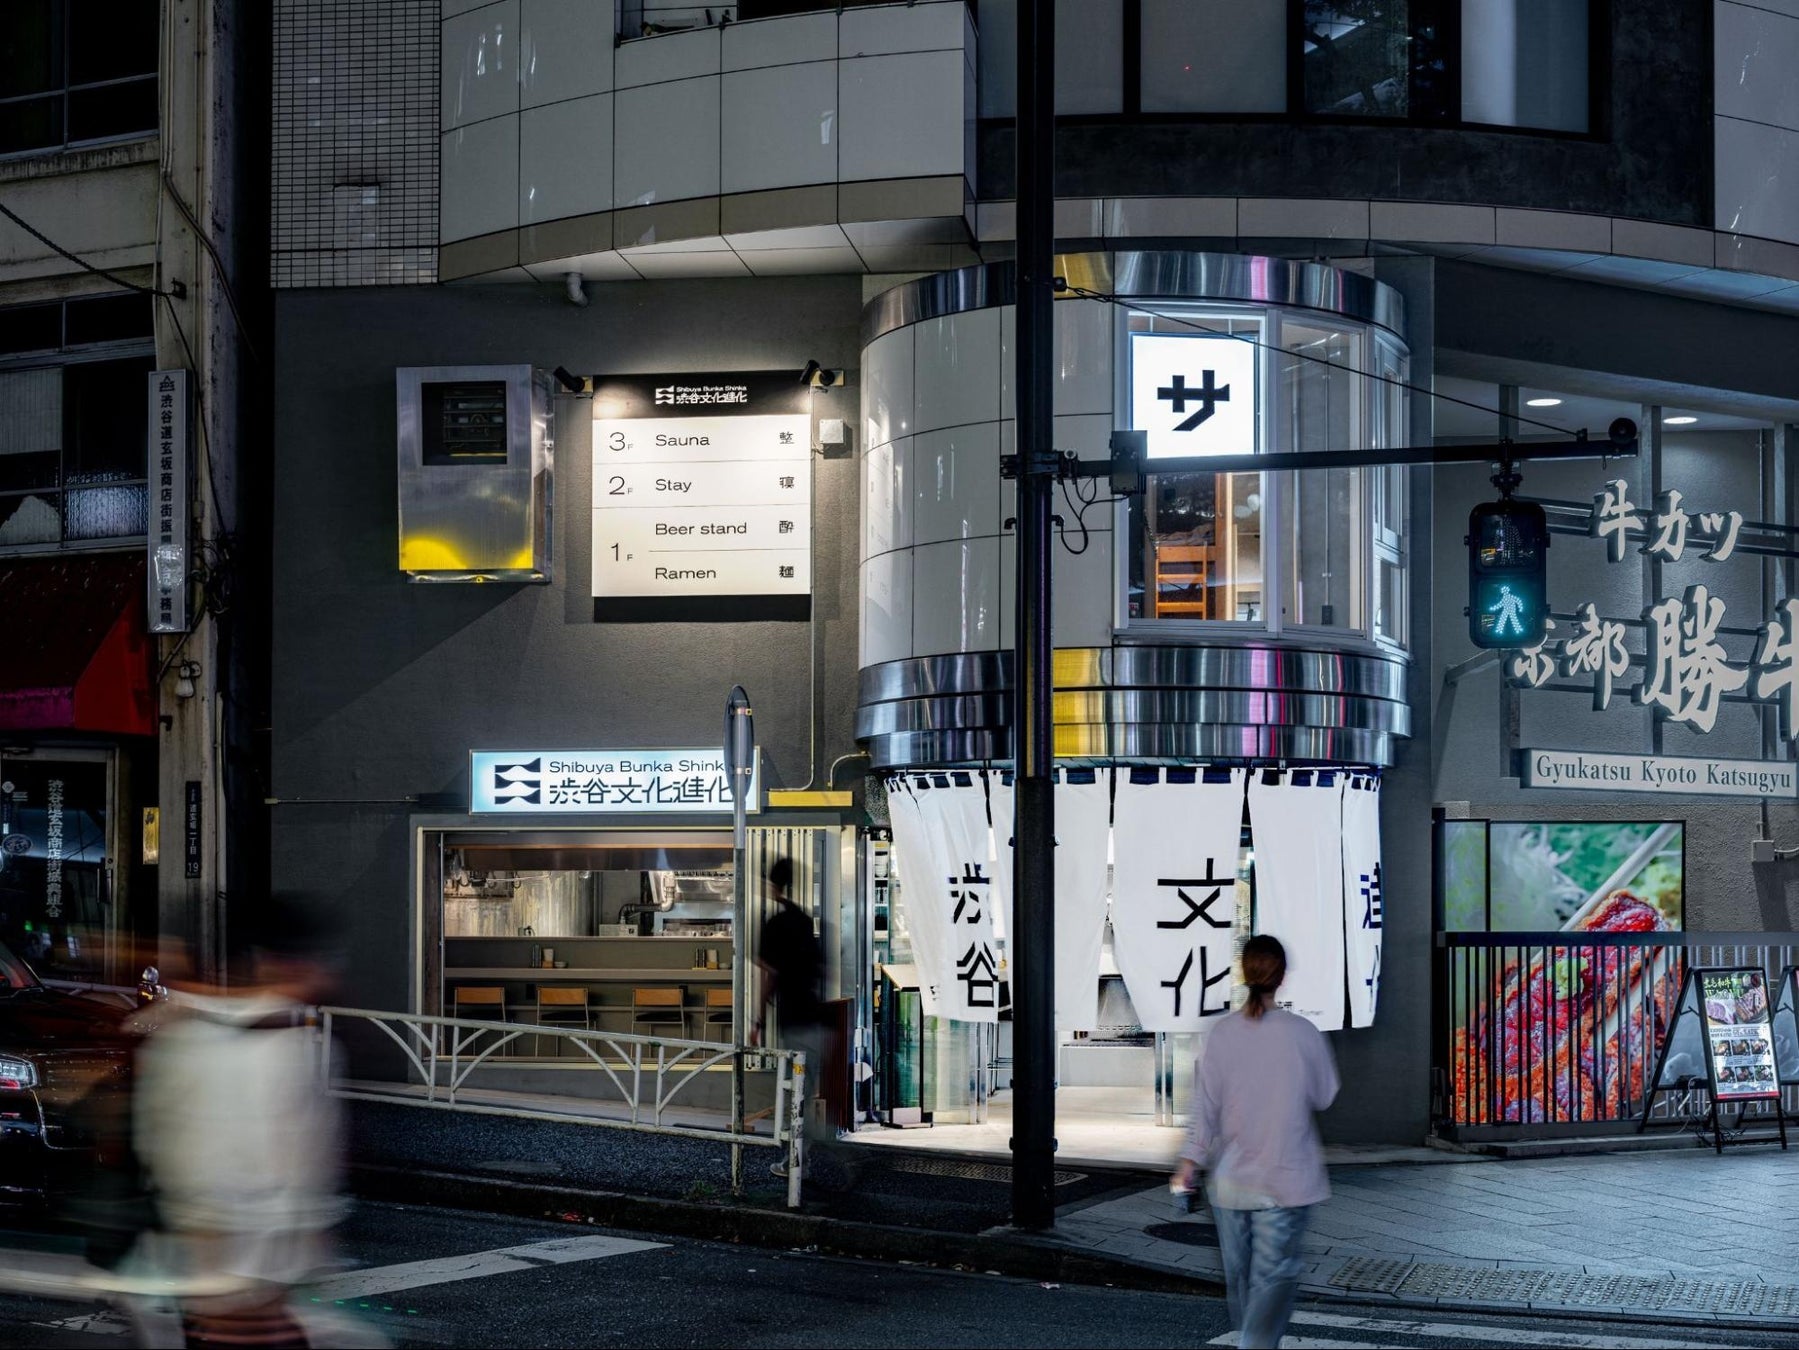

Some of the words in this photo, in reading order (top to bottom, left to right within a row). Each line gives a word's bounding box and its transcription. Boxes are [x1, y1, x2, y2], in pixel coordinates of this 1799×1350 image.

[676, 392, 748, 404] 渋谷文化進化
[1157, 369, 1231, 432] サ
[655, 434, 710, 447] Sauna
[779, 431, 794, 445] 整
[655, 478, 692, 493] Stay
[655, 523, 694, 536] Beer
[700, 522, 747, 535] stand
[778, 520, 794, 533] 酔
[1598, 478, 1743, 562] 牛カツ
[655, 567, 717, 579] Ramen
[549, 760, 615, 775] Shibuya
[620, 759, 674, 772] Bunka
[678, 758, 724, 772] Shink
[1536, 754, 1631, 786] Gyukatsu
[1640, 760, 1697, 788] Kyoto
[1706, 763, 1792, 793] Katsugyu
[549, 776, 735, 805] 渋谷文化進化
[188, 862, 200, 872] 19
[1156, 857, 1236, 1018] 文化
